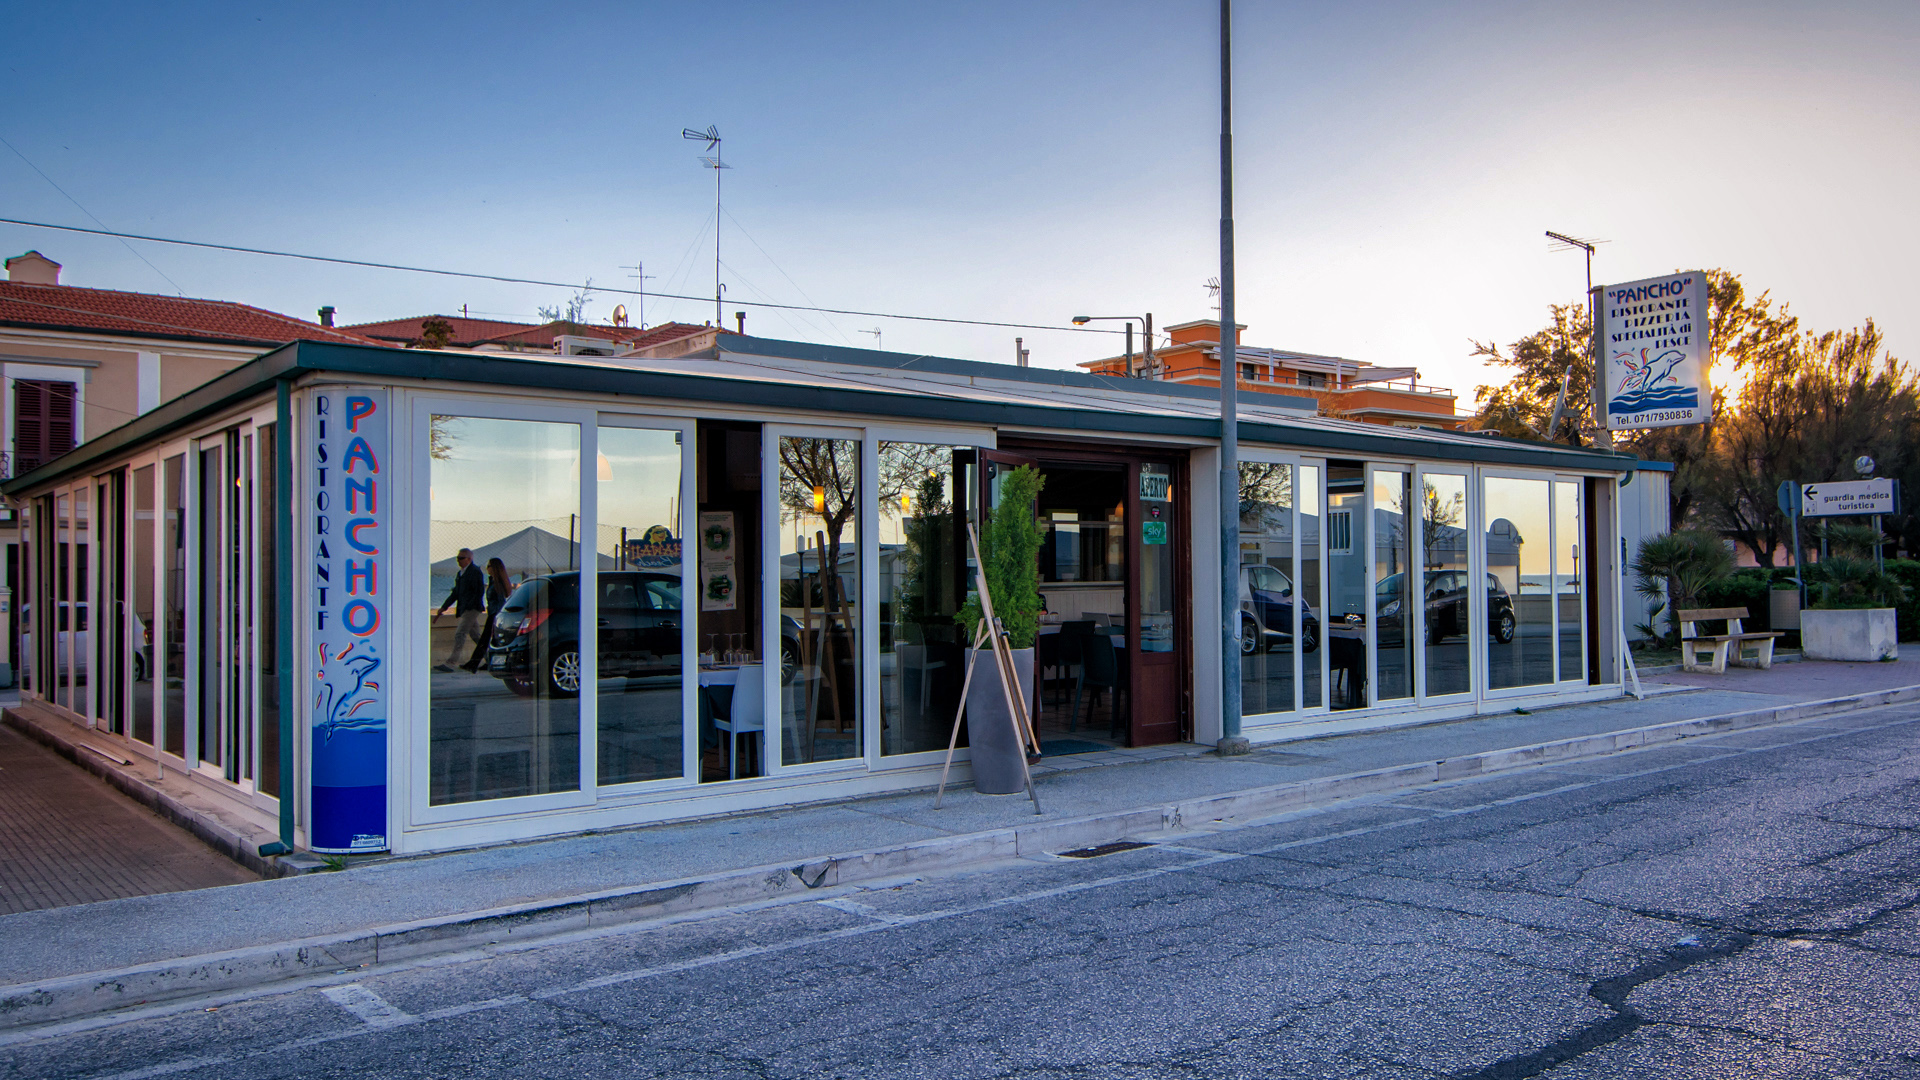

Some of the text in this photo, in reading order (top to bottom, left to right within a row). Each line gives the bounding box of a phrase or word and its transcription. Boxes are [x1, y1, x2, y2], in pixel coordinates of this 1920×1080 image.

[1611, 298, 1691, 318] RISTORANTE
[1624, 311, 1691, 329] PIZZERIA
[1611, 323, 1692, 343] SPECIALITÀ di
[1655, 336, 1692, 349] PESCE
[1616, 409, 1693, 425] Tel. 071/7930836
[1823, 492, 1890, 503] guardia medica
[1838, 502, 1875, 510] turistica
[342, 396, 381, 637] PANCHO
[1147, 526, 1161, 537] sky
